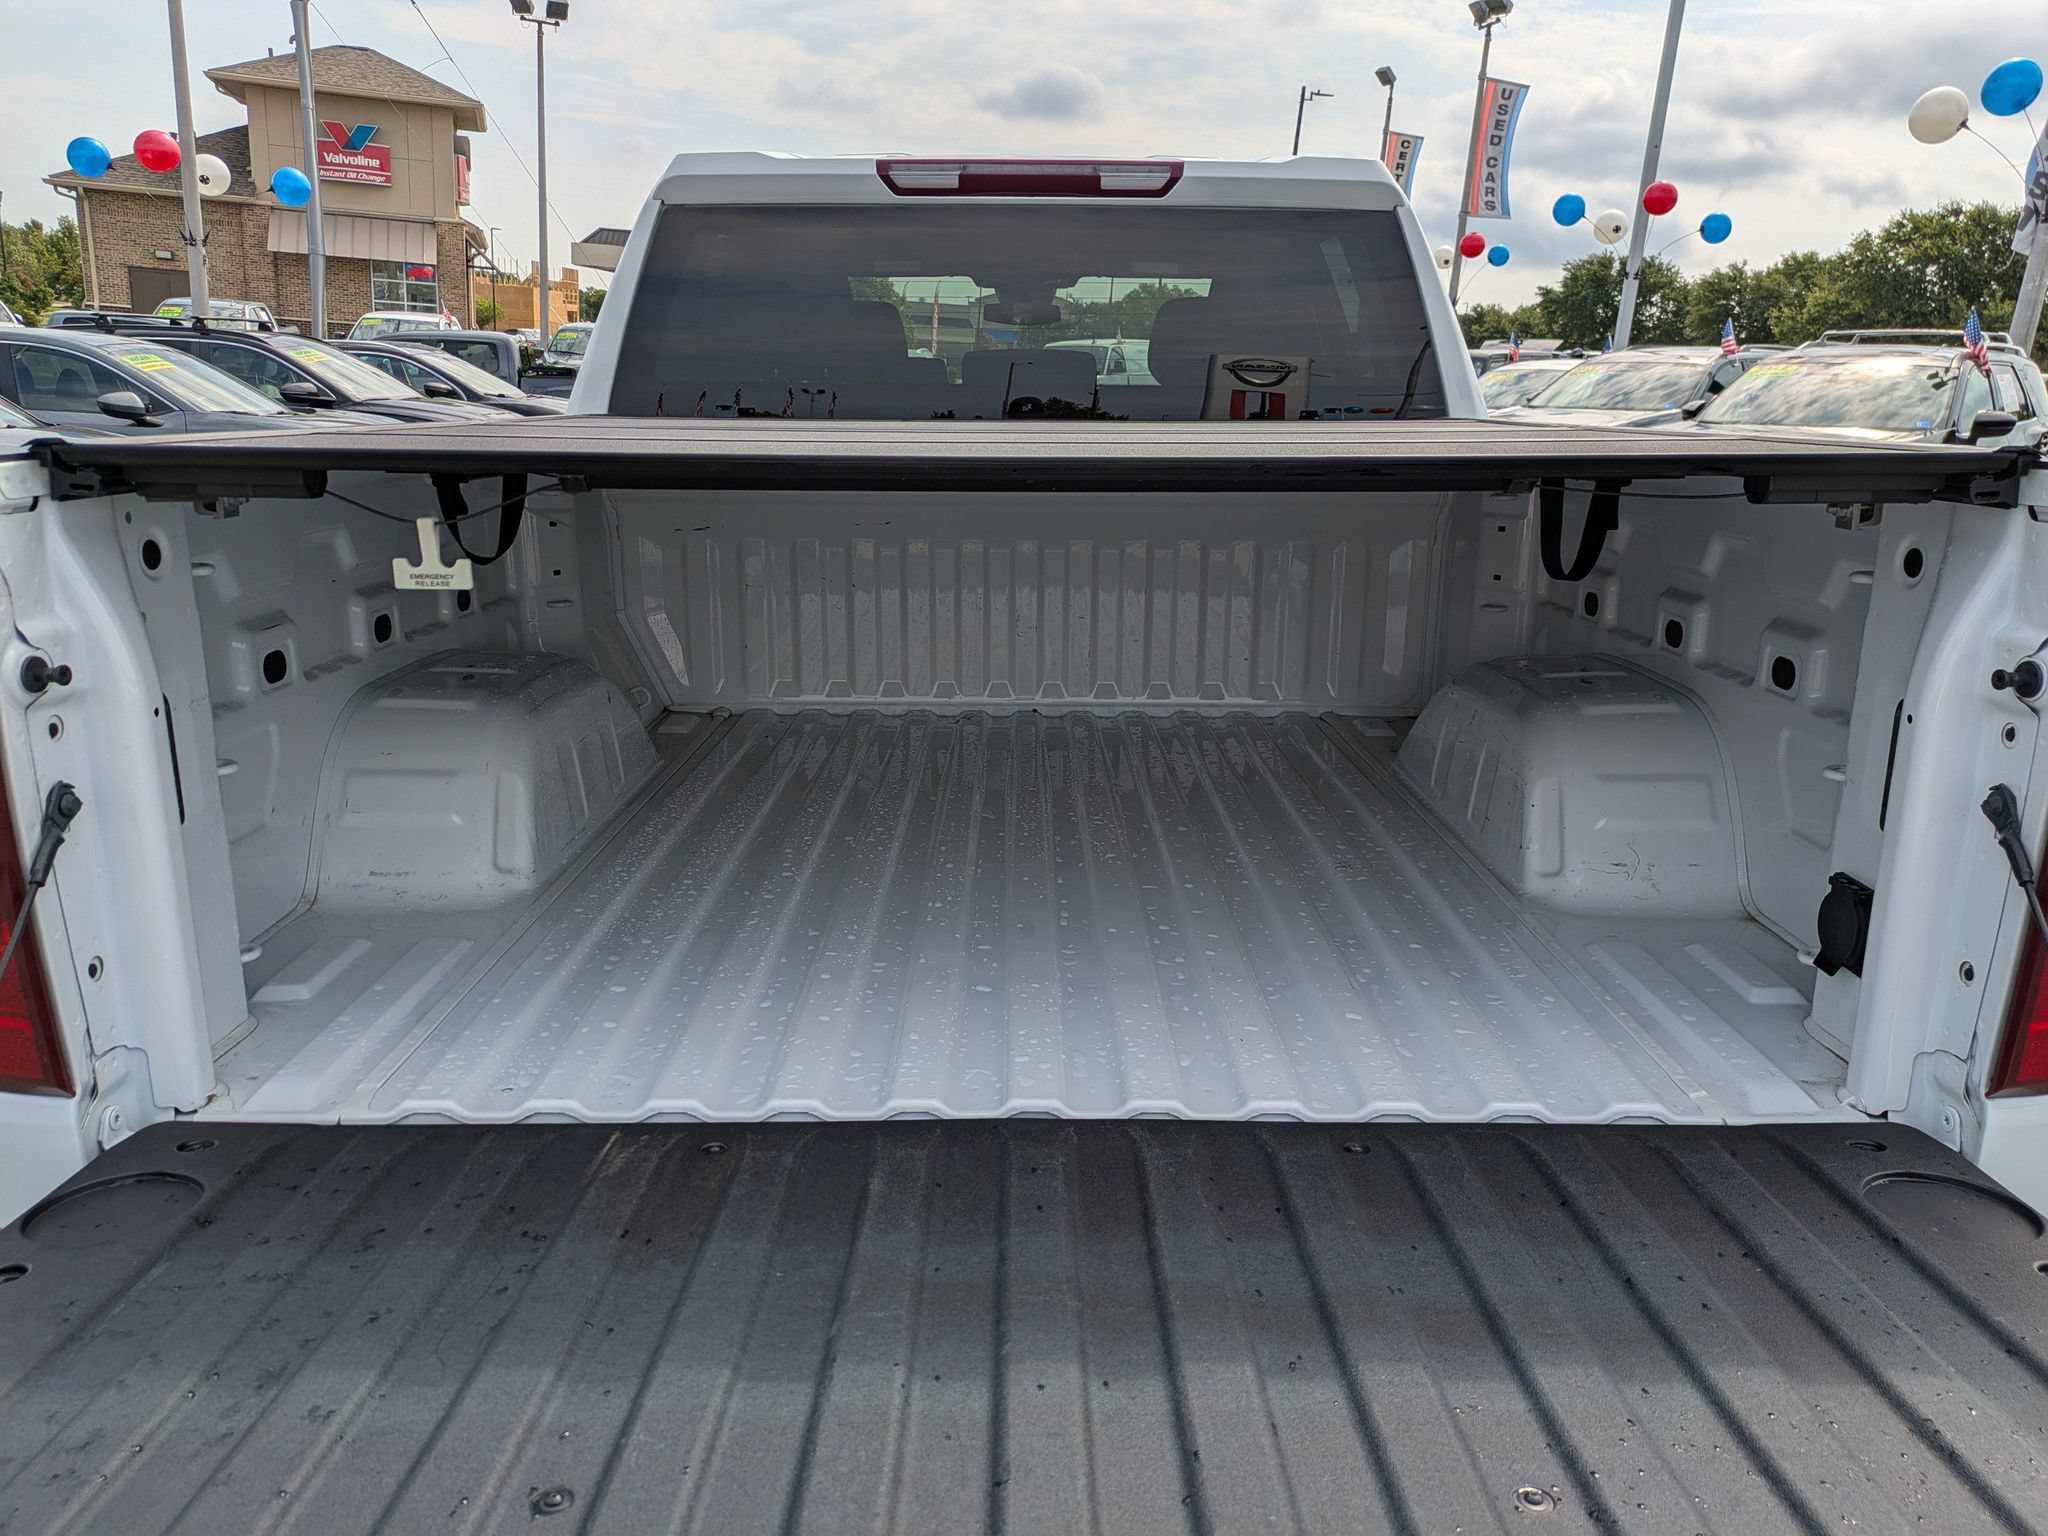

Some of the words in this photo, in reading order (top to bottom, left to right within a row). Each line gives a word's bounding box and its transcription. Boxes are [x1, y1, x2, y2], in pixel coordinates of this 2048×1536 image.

[1489, 87, 1514, 147] USED
[320, 169, 346, 178] Instant
[346, 171, 357, 179] Oil
[358, 173, 387, 183] Change
[323, 152, 381, 168] Valvoline
[1484, 156, 1498, 212] CARS
